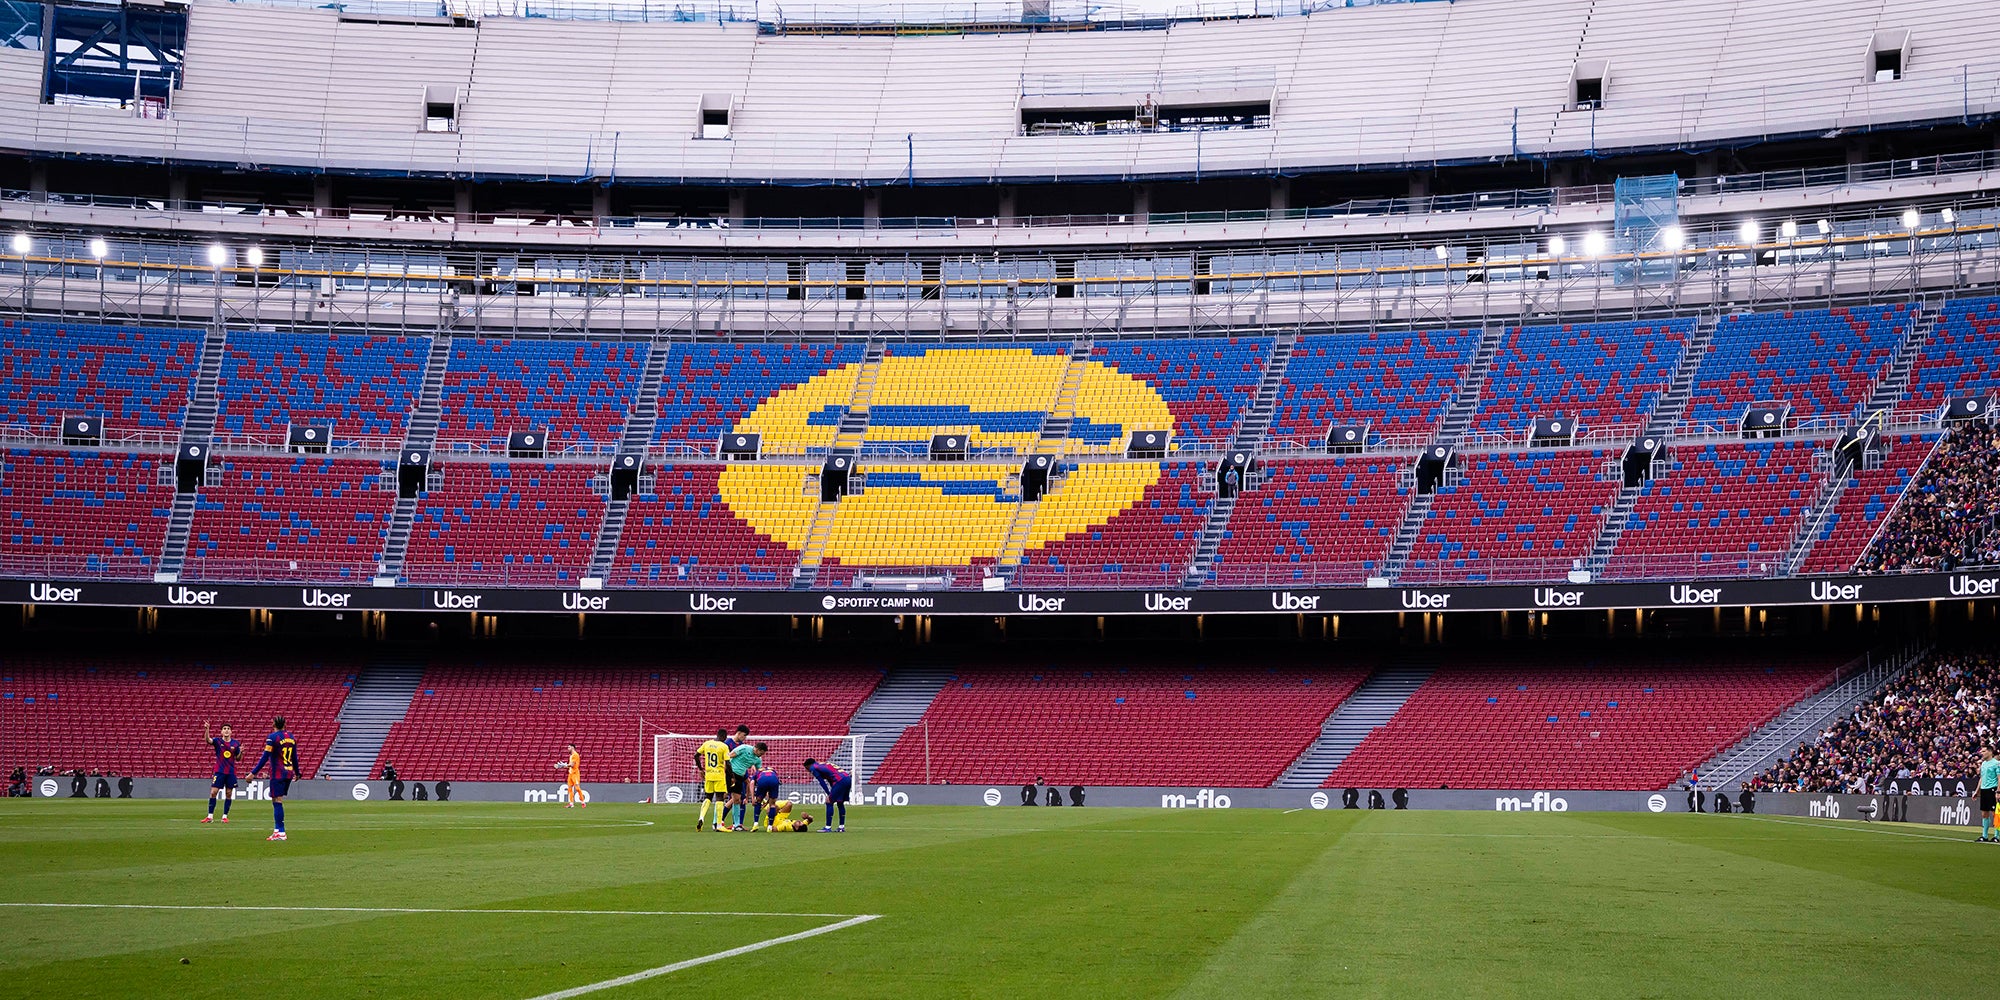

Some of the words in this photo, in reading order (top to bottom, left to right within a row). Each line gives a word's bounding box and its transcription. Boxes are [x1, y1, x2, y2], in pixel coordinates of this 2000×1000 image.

[31, 583, 81, 601] Uber
[1671, 585, 1721, 603] Uber
[1811, 581, 1862, 600] Uber
[1950, 575, 2000, 595] Uber
[168, 587, 217, 604] Uber
[303, 589, 351, 606] Uber
[434, 591, 481, 608] Uber
[563, 592, 610, 610] Uber
[690, 594, 736, 611] Uber
[838, 598, 880, 608] SPOTIFY
[881, 598, 911, 608] CAMP
[912, 598, 934, 608] NOU
[1019, 594, 1066, 612] Uber
[1145, 593, 1192, 610] Uber
[1272, 592, 1320, 609] Uber
[1402, 590, 1450, 608] Uber
[1535, 588, 1584, 606] Uber
[282, 747, 293, 765] 11
[706, 752, 718, 767] 19
[1162, 788, 1231, 808] m-flo
[1496, 792, 1568, 811] m-flo
[1810, 795, 1840, 818] m-flo
[1940, 799, 1971, 826] m-flo
